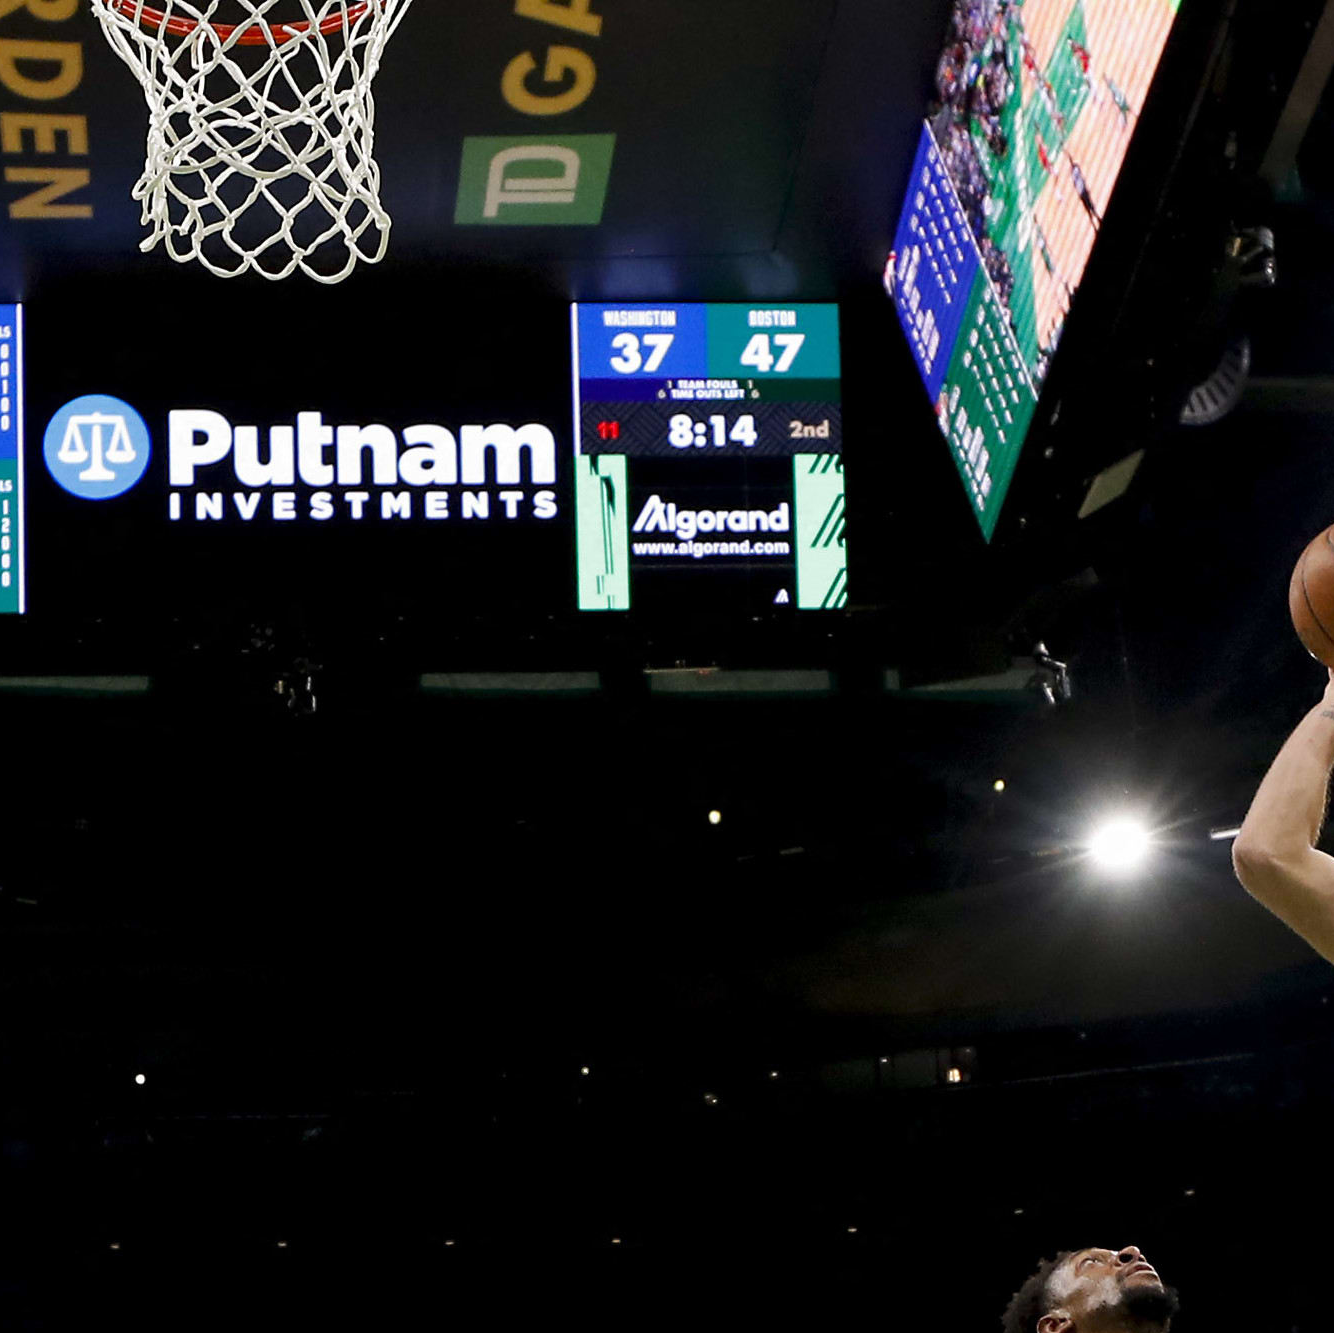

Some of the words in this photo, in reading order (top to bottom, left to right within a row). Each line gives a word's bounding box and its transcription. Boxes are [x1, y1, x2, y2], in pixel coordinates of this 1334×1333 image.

[603, 310, 676, 327] WASHINGTON
[748, 310, 797, 327] BOSTON
[610, 332, 675, 373] 37
[740, 333, 805, 372] 47
[671, 389, 695, 399] TIME
[696, 389, 722, 399] OUTS
[724, 389, 745, 399] LEFT
[678, 380, 704, 389] TEAM
[706, 380, 738, 389] FOULS
[597, 421, 620, 439] 11
[668, 414, 757, 448] 8:14
[789, 420, 830, 438] 2nd
[169, 410, 555, 487] Putnam
[169, 491, 558, 520] INVESTMENTS
[633, 495, 790, 539] Algorand
[632, 540, 790, 558] www.algorand.com
